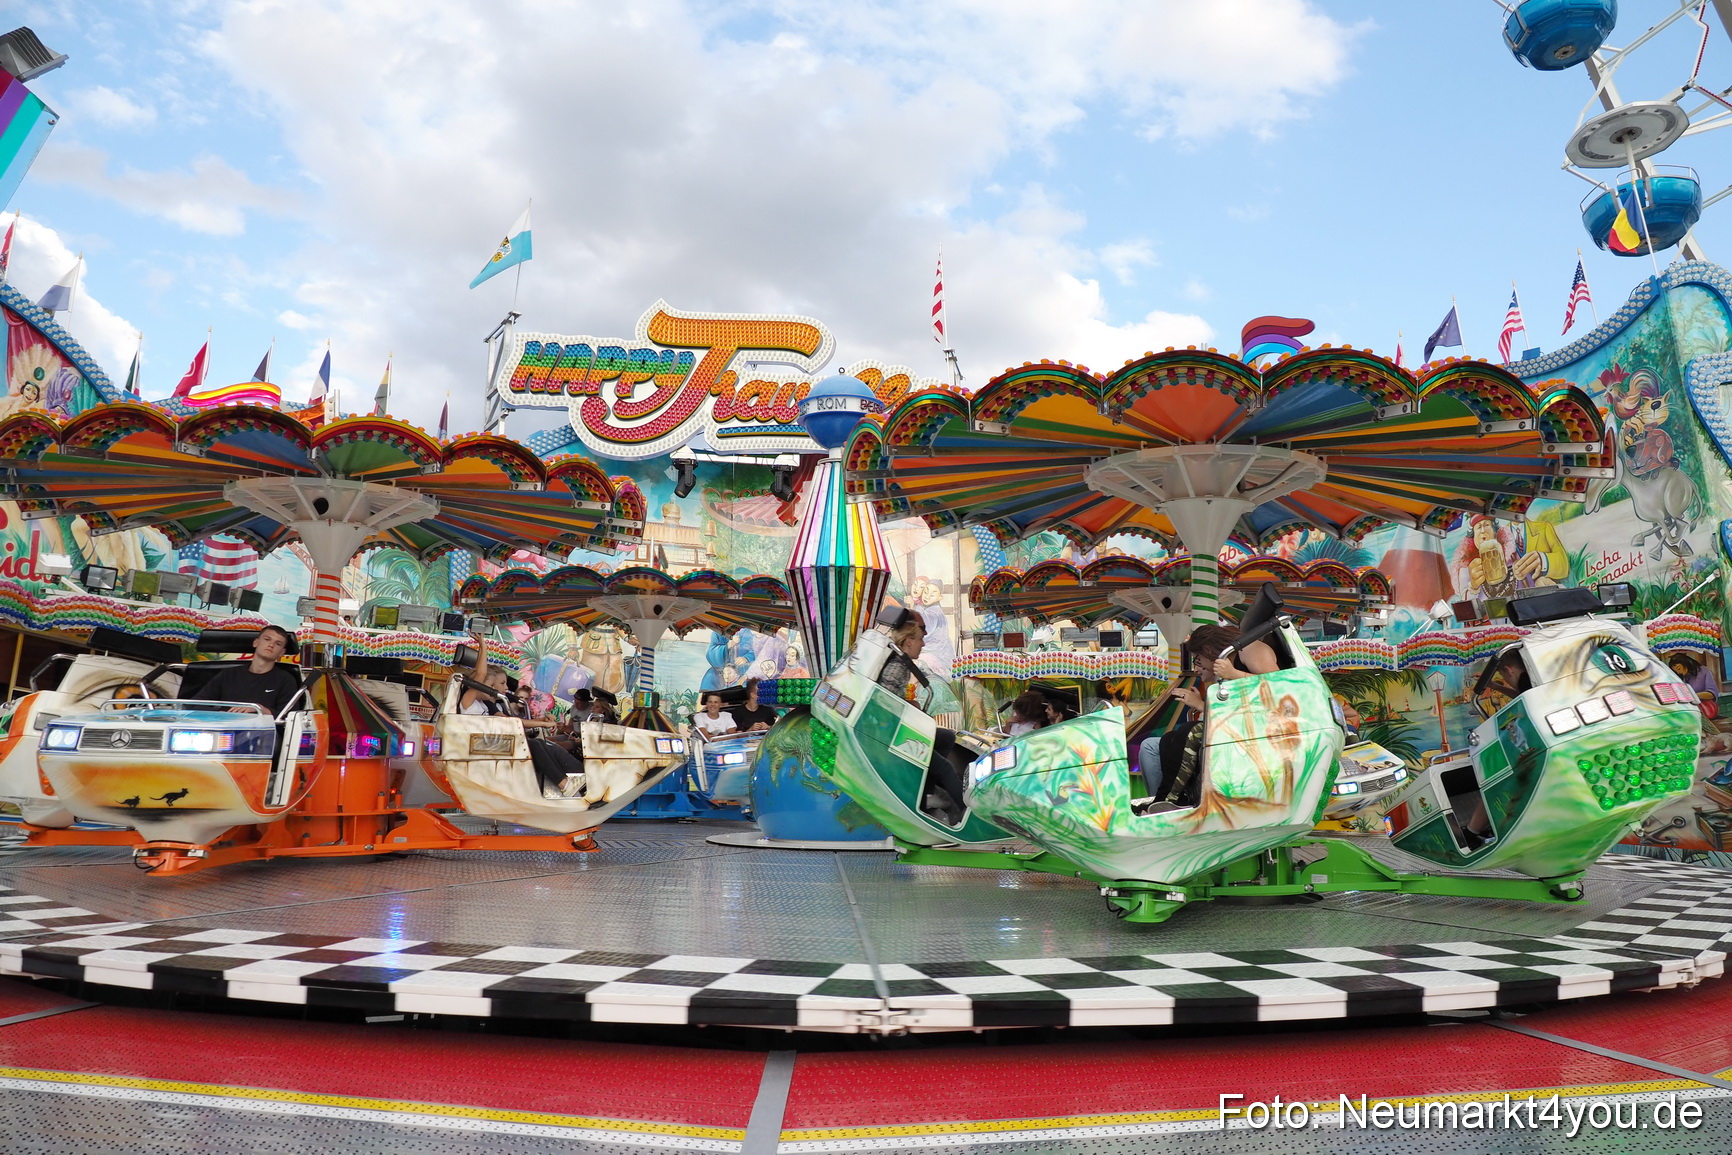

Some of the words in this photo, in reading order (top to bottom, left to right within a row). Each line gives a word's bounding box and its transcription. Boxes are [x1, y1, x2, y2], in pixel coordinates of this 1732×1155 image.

[816, 397, 847, 411] ROM
[1578, 551, 1644, 592] eimaakt
[1605, 654, 1627, 670] 10
